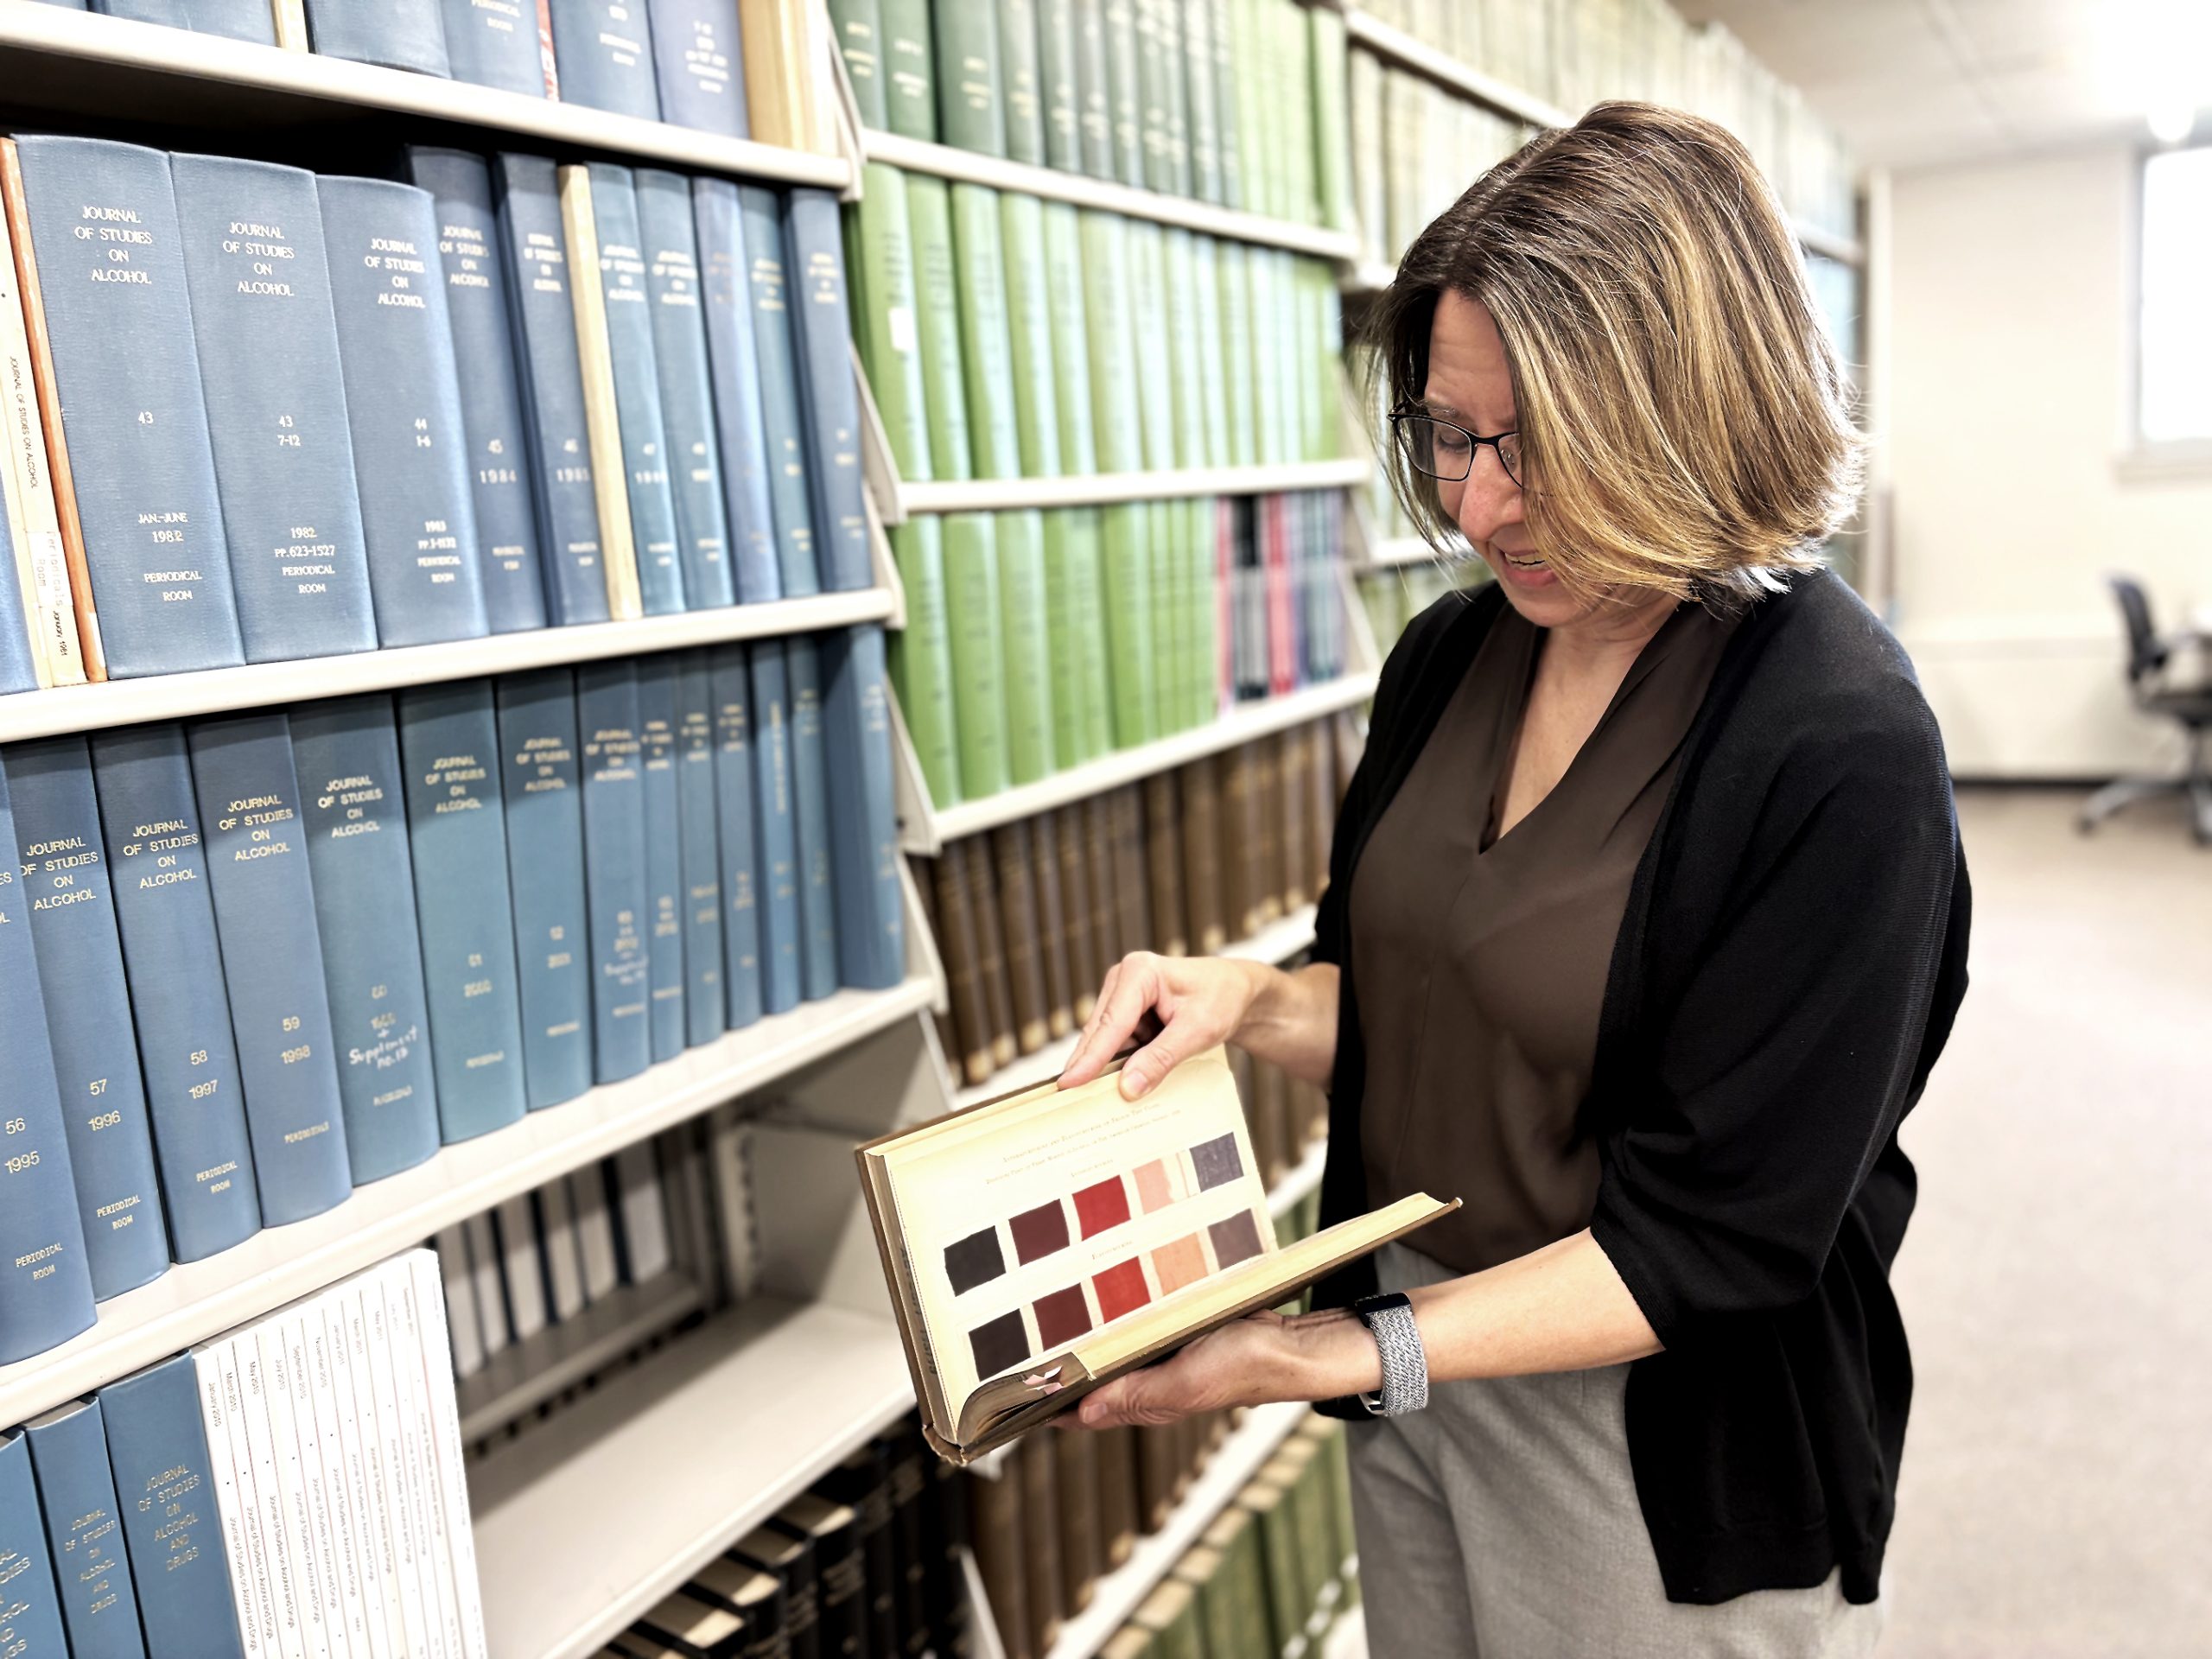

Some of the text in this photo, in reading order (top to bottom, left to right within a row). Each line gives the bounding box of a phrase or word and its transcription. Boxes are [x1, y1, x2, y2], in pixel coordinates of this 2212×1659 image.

[83, 206, 142, 223] JOURNAL
[74, 226, 152, 245] OF STUDIES
[230, 222, 284, 239] JOURNAL
[223, 240, 295, 258] OF STUDIES
[371, 238, 420, 255] JOURNAL
[440, 241, 453, 252] OF
[108, 249, 129, 262] ON
[254, 263, 272, 275] ON
[365, 256, 428, 275] OF STUDIES
[92, 269, 152, 284] ALCOHOL
[392, 276, 409, 288] ON
[238, 281, 295, 296] ALCOHOL
[378, 294, 427, 308] ALCOHOL
[10, 356, 38, 489] JOURNAL OF STUDIES ON ALCOHOL
[138, 411, 153, 423] 43
[279, 415, 293, 427] 43
[277, 435, 301, 446] 7-12
[152, 531, 183, 543] 1982
[290, 527, 317, 538] 1982
[144, 571, 202, 582] PERIODICAL
[283, 565, 335, 575] PERIODICAL
[162, 590, 193, 601] ROOM
[298, 584, 326, 594] ROOM
[53, 611, 61, 638] January
[326, 776, 372, 791] JOURNAL
[425, 773, 440, 785] OF
[228, 795, 282, 812] JOURNAL
[318, 788, 383, 808] OF STUDIES
[219, 809, 293, 830] OF STUDIES
[347, 808, 363, 819] ON
[133, 820, 188, 836] JOURNAL
[251, 830, 270, 841] ON
[332, 822, 380, 838] ALCOHOL
[27, 837, 86, 856] JOURNAL
[124, 834, 198, 855] OF STUDIES
[235, 842, 290, 861] ALCOHOL
[45, 852, 98, 871] STUDIES
[158, 855, 175, 867] ON
[54, 874, 73, 887] ON
[140, 869, 197, 888] ALCOHOL
[35, 889, 96, 910] ALCOHOL
[283, 1016, 300, 1031] 59
[191, 1050, 207, 1065] 58
[281, 1046, 310, 1064] 1998
[91, 1079, 106, 1095] 57
[189, 1080, 217, 1099] 1997
[6, 1118, 25, 1134] 56
[88, 1111, 121, 1131] 1996
[4, 1151, 39, 1173] 1995
[196, 1161, 238, 1181] PERIODICAL
[211, 1179, 230, 1193] ROOM
[97, 1195, 141, 1217] PERIODICAL
[112, 1215, 133, 1230] ROOM
[16, 1243, 62, 1268] PERIODICAL
[33, 1265, 55, 1280] ROOM
[228, 1395, 237, 1411] 2010
[147, 1464, 189, 1491] JOURNAL
[139, 1474, 200, 1511] OF STUDIES
[166, 1503, 181, 1516] ON
[155, 1512, 198, 1541] ALCOHOL
[171, 1534, 188, 1551] AND
[167, 1547, 198, 1571] DRUGS
